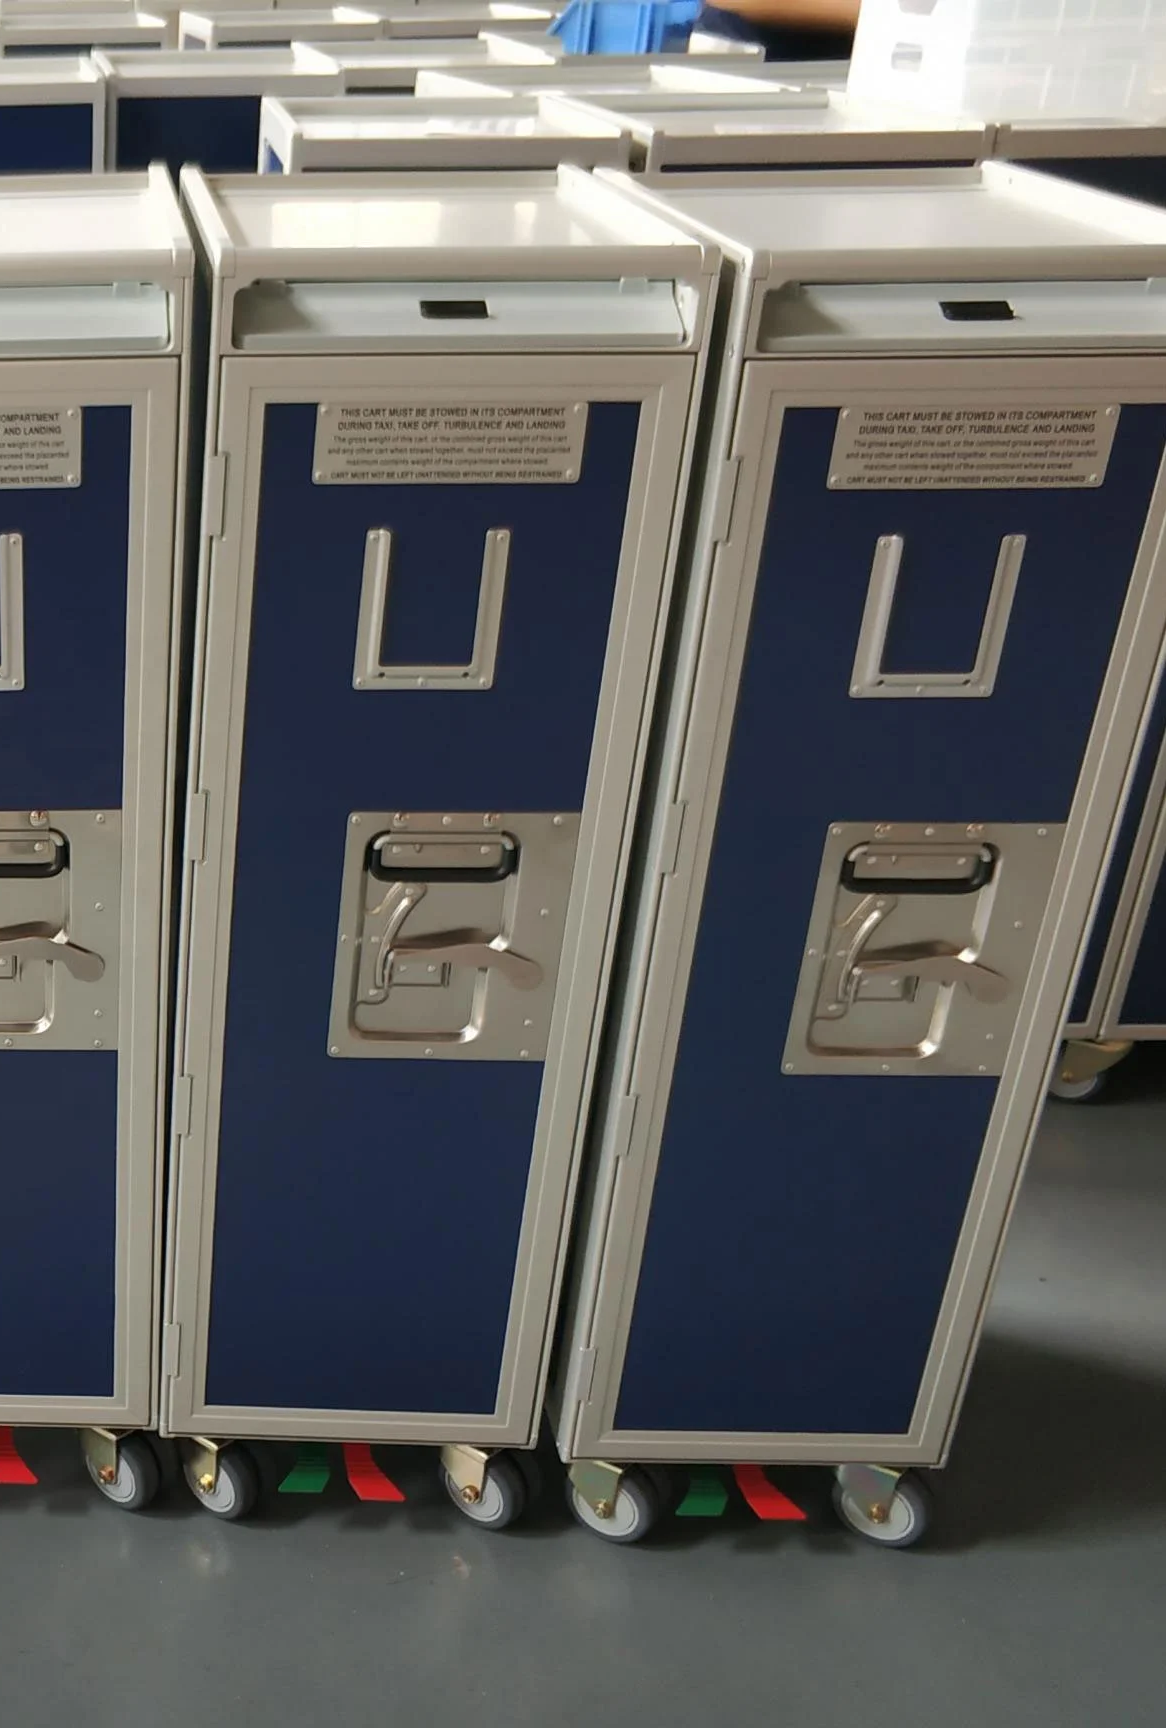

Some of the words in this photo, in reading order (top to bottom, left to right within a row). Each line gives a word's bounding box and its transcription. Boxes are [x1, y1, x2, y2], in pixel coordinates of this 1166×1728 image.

[340, 408, 361, 417] THIS
[362, 408, 387, 417] CART
[388, 408, 414, 417] MUST
[415, 408, 428, 416] BE
[430, 408, 469, 416] STOWED
[471, 408, 480, 416] IN
[481, 408, 496, 416] ITS
[497, 407, 566, 416] COMPARTMENT
[862, 412, 884, 421] THIS
[885, 412, 911, 421] CART
[911, 412, 938, 421] MUST
[939, 412, 953, 421] BE
[954, 411, 995, 421] STOWED
[996, 411, 1007, 420] IN
[1007, 411, 1024, 420] ITS
[1024, 410, 1096, 420] COMPARTMENT
[337, 421, 373, 430] DURING
[397, 421, 420, 430] TAKE
[444, 421, 503, 430] TURBULENCE
[505, 420, 525, 429] AND
[527, 420, 567, 429] LANDING
[858, 425, 896, 434] DURING
[919, 425, 944, 434] TAKE
[944, 425, 967, 435] OFF,
[967, 424, 1030, 434] TURBULENCE
[1031, 424, 1052, 433] AND
[1053, 424, 1096, 433] LANDING
[3, 427, 22, 436] AND
[24, 426, 62, 435] LANDING
